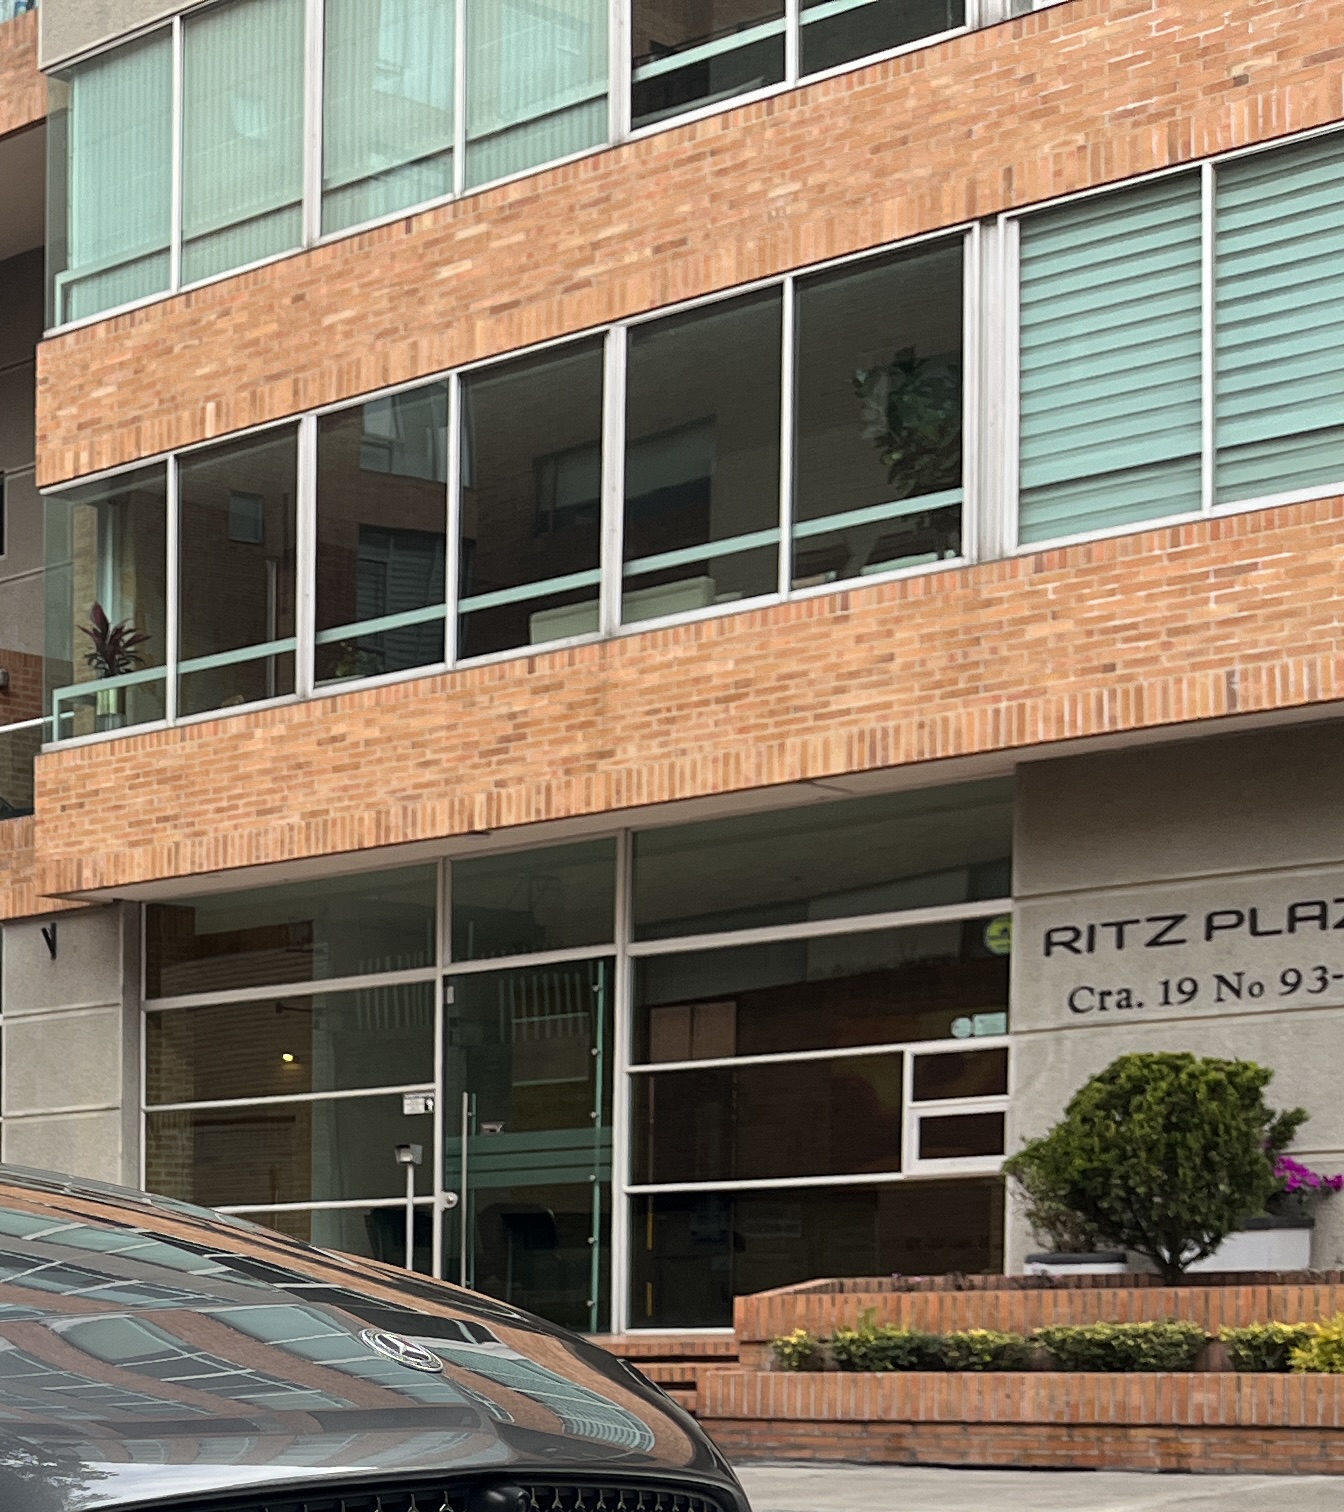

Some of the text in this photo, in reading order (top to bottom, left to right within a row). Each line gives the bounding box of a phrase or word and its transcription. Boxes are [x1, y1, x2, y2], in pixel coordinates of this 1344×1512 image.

[1043, 913, 1187, 957] RITZ
[1067, 984, 1144, 1014] Cra.
[1160, 976, 1199, 1007] 19
[1212, 971, 1265, 1002] No
